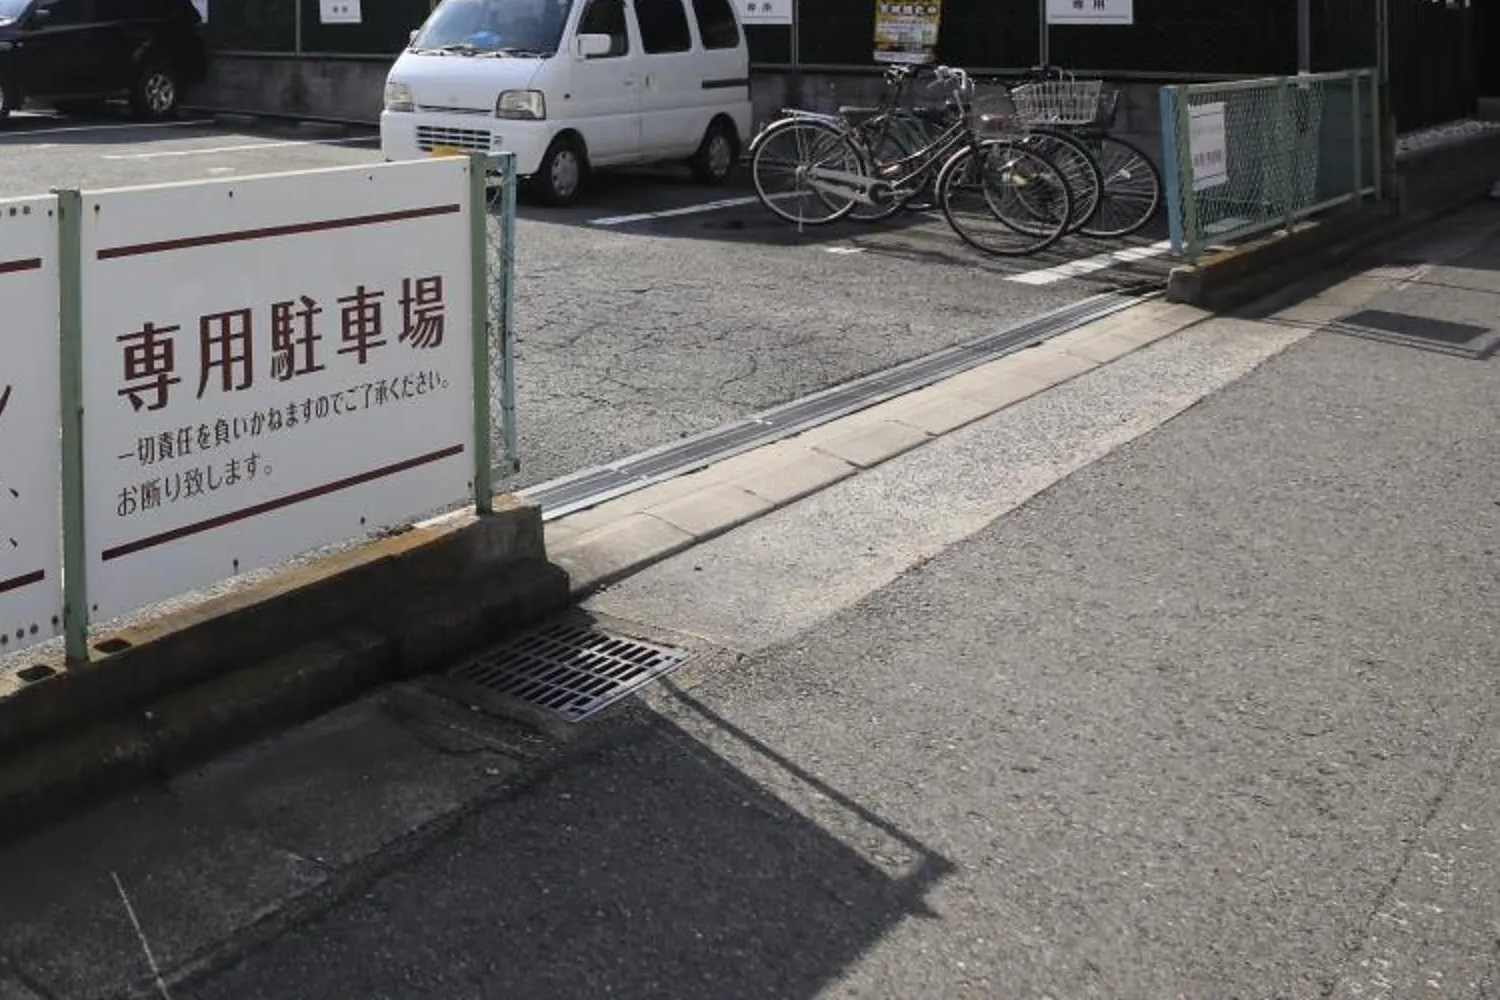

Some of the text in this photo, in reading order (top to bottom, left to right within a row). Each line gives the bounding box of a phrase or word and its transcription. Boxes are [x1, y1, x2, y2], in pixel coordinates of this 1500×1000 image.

[116, 275, 446, 412] 専用駐車場
[117, 368, 450, 466] 一切責任を負いかねますのでご了承ください。
[116, 451, 274, 518] お断り致します。
